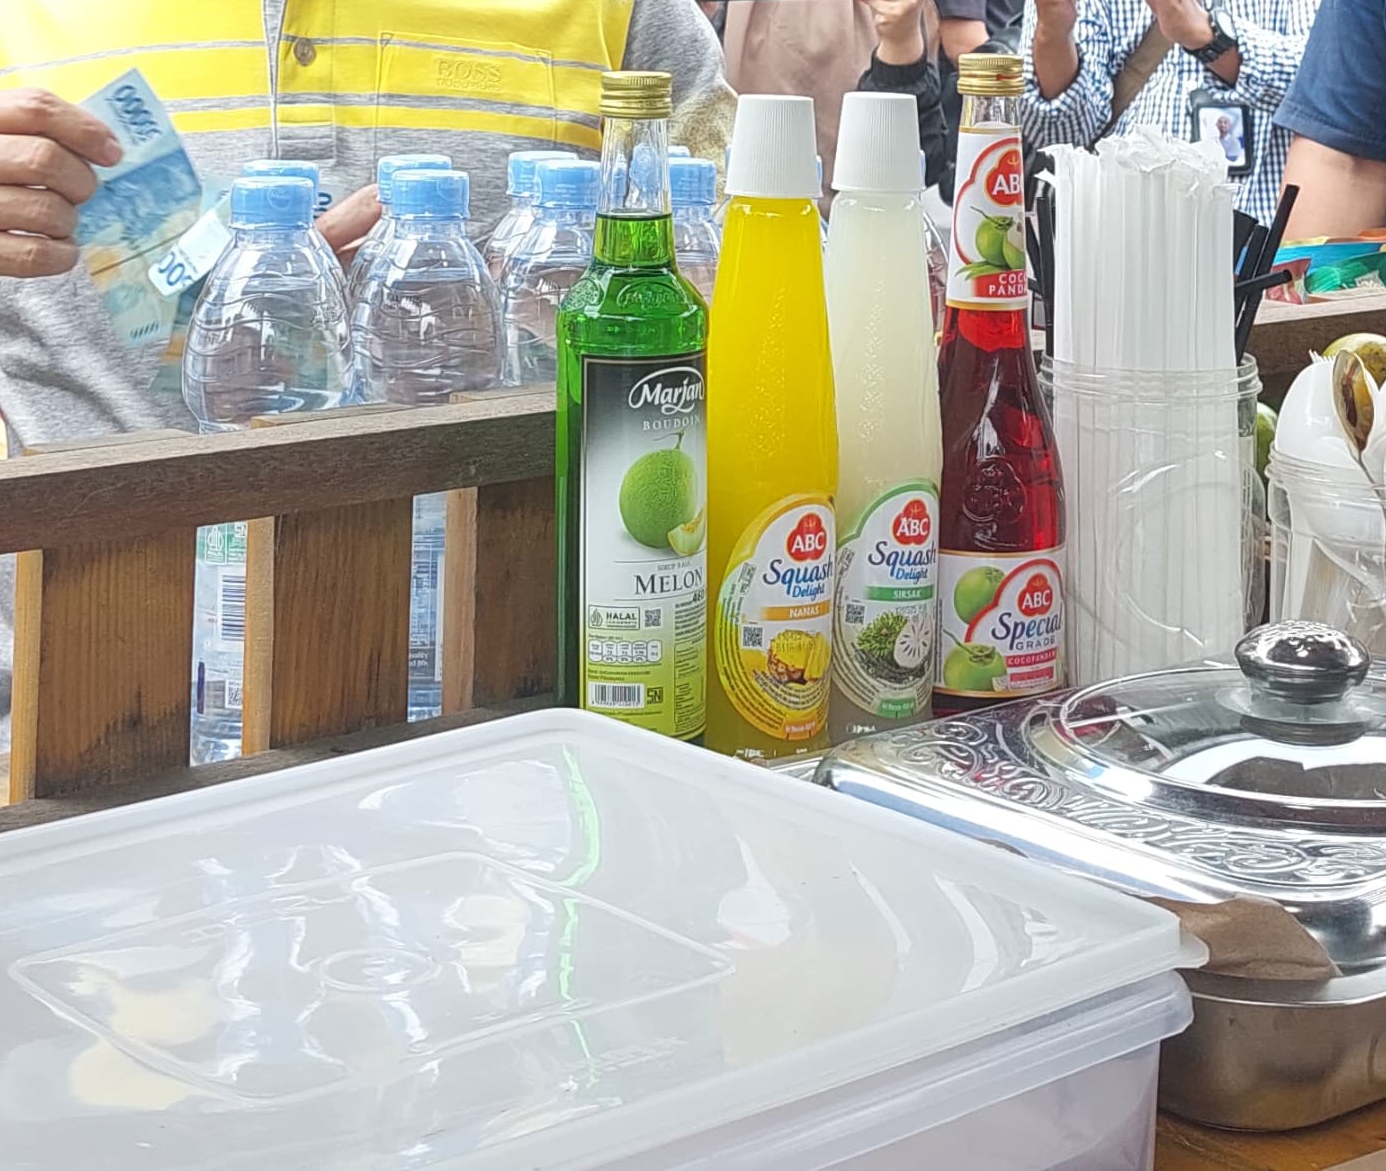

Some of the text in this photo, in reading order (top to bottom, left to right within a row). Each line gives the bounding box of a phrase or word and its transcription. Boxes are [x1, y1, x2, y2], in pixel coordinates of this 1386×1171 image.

[436, 59, 503, 83] BOSS
[991, 173, 1023, 196] AB
[988, 283, 1028, 296] PAND
[630, 367, 705, 415] Marjan
[896, 516, 929, 537] ABC
[791, 532, 825, 553] ABC
[867, 541, 937, 577] Squash
[635, 566, 703, 595] MELON
[762, 553, 834, 596] Squash
[895, 568, 928, 585] Delight
[792, 583, 826, 602] Delight
[1021, 589, 1051, 609] ABC
[606, 611, 637, 621] HALAL
[789, 606, 820, 618] NANAS
[991, 603, 1062, 650] Special
[1015, 635, 1056, 650] GRADE
